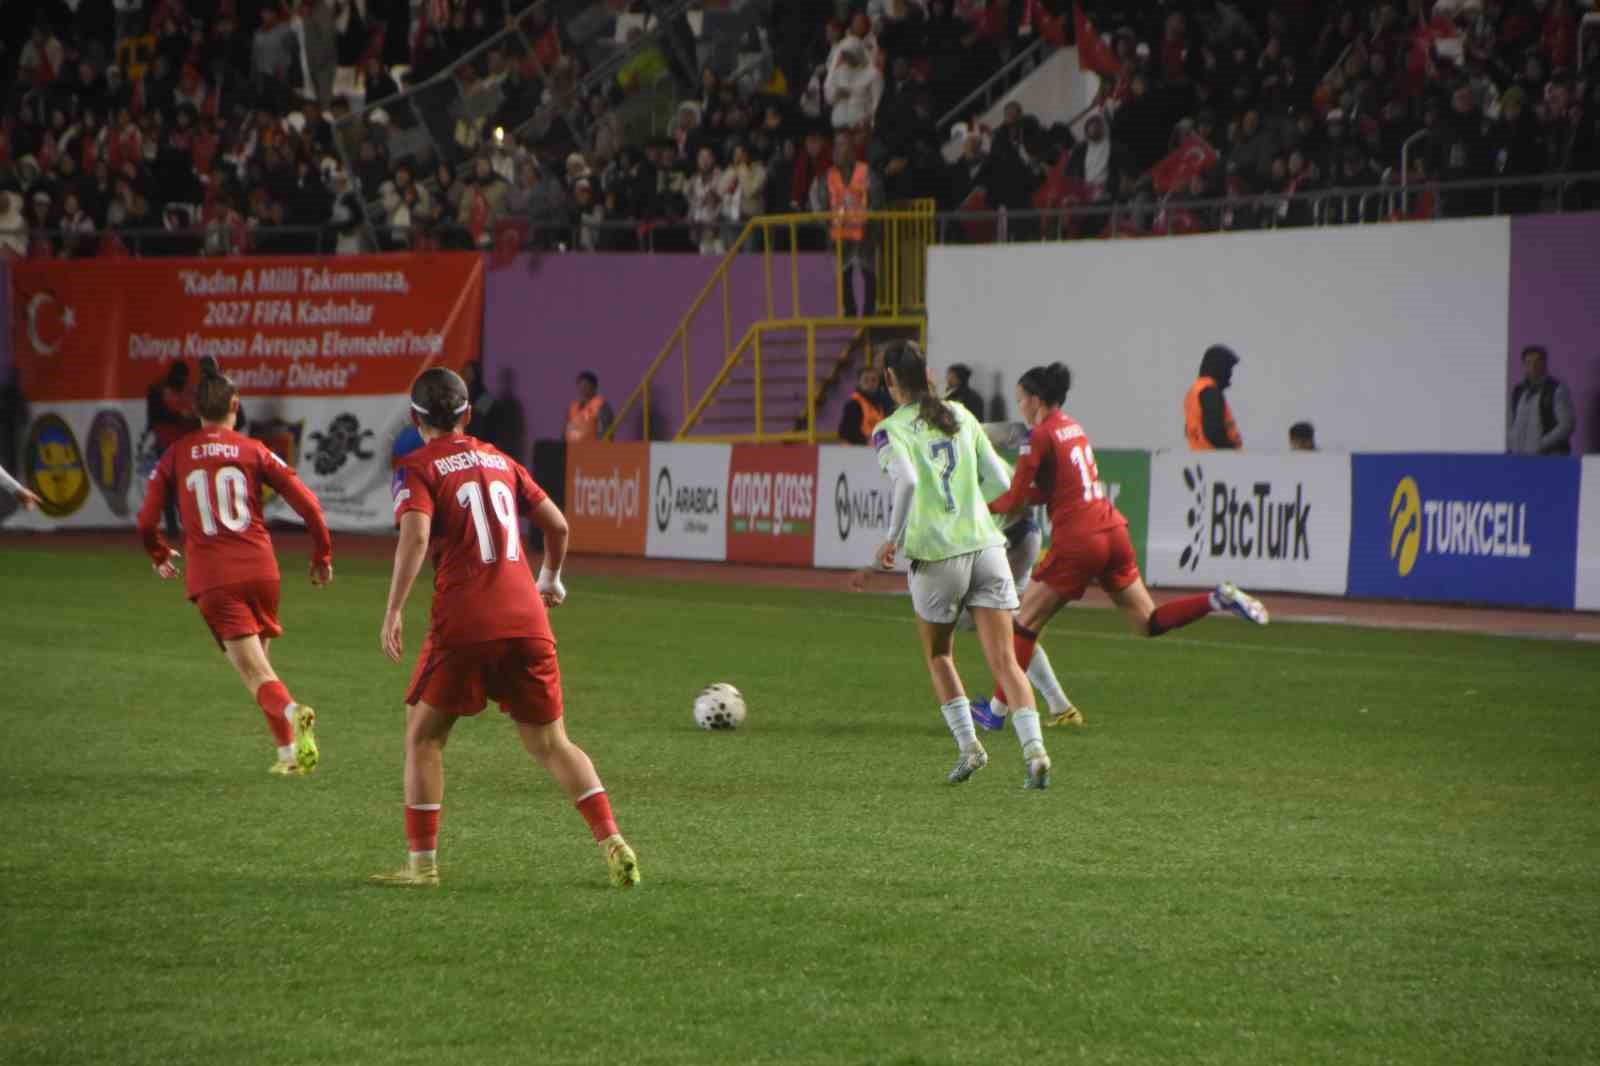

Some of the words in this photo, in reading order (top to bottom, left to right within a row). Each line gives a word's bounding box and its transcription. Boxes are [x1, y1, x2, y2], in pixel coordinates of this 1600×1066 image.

[241, 269, 254, 293] A
[204, 302, 252, 326] 2027
[254, 301, 293, 325] FIFA
[250, 332, 318, 359] Avrupa
[434, 450, 481, 477] BUSEM
[928, 438, 959, 513] 7
[186, 466, 251, 536] 10
[456, 480, 520, 563] 19
[574, 465, 640, 528] trendyol
[675, 485, 719, 514] ARABICA
[732, 472, 772, 533] anpa
[773, 472, 813, 537] gross
[1210, 482, 1311, 561] BtcTurk
[1424, 499, 1533, 558] TURKCELL
